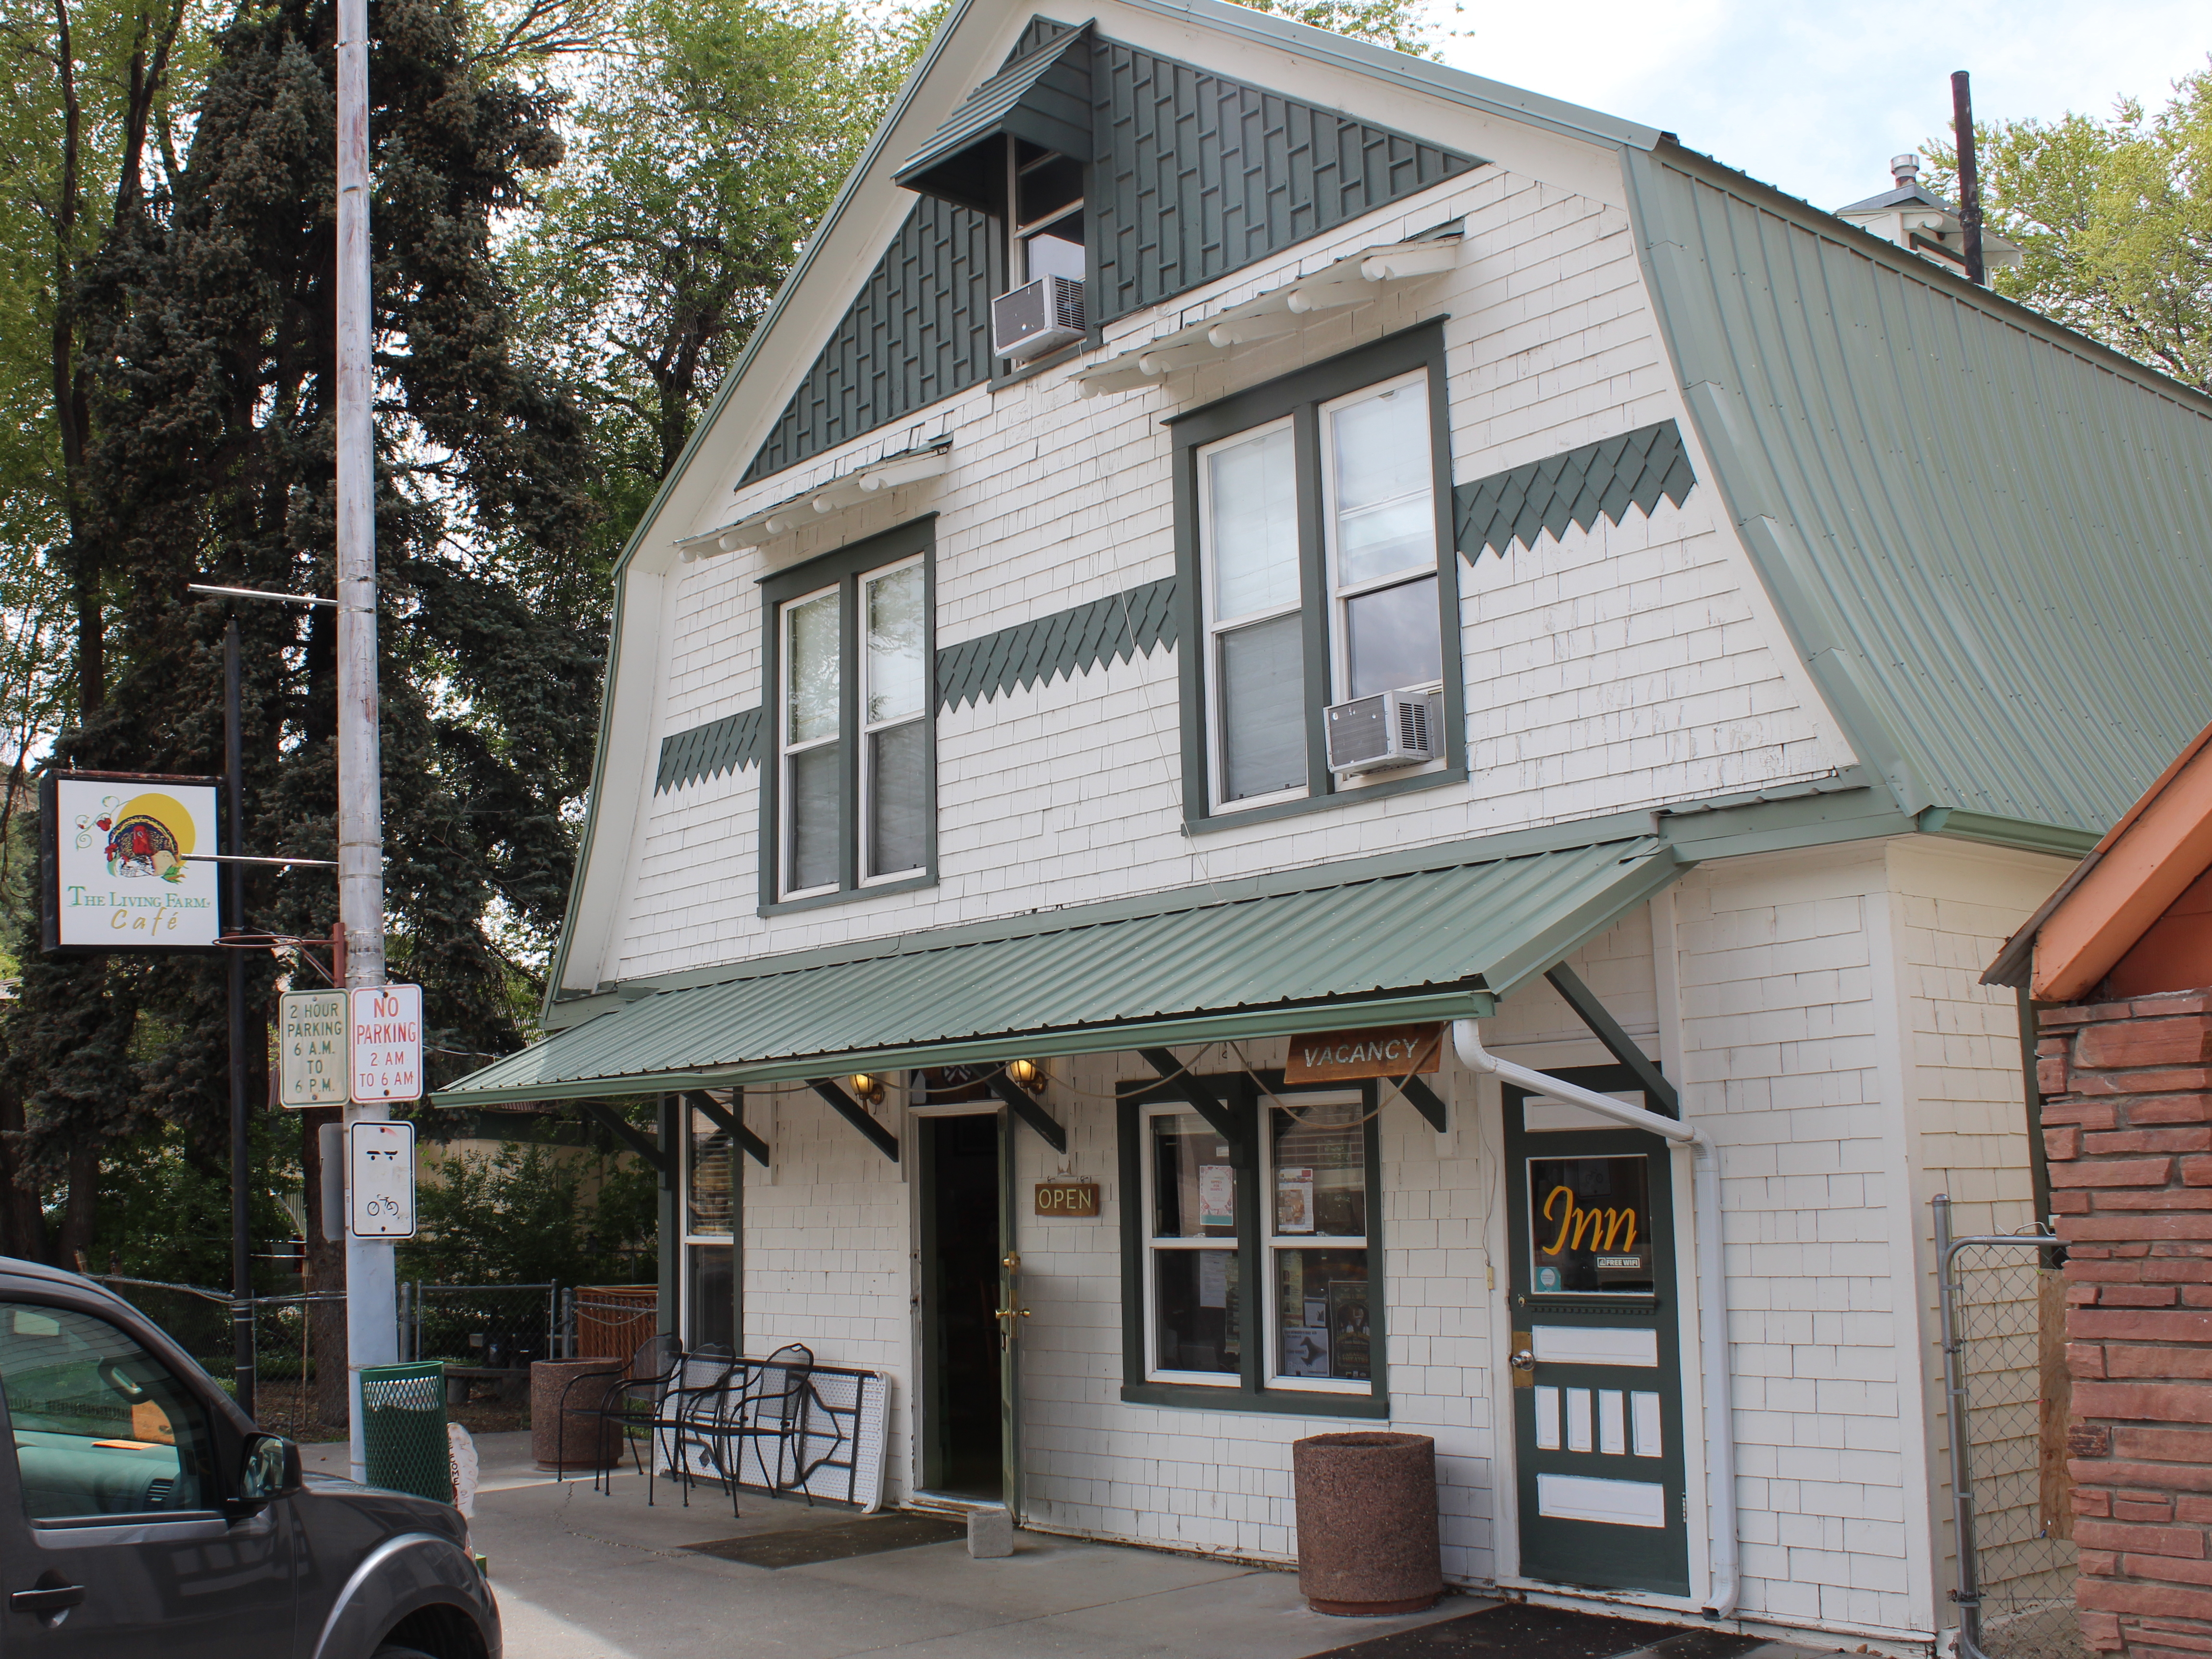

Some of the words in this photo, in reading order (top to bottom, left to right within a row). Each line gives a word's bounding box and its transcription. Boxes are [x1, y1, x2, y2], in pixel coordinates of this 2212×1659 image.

[109, 892, 161, 908] LIVING
[111, 906, 178, 936] Café
[290, 1005, 297, 1019] 2
[304, 1003, 338, 1018] HOUR
[373, 997, 399, 1018] NO
[287, 1021, 342, 1038] PARKING
[357, 1021, 417, 1045] PARKING
[294, 1042, 301, 1056] 6
[309, 1040, 335, 1055] A.M.
[1304, 1037, 1420, 1067] VACANCY
[307, 1060, 323, 1074] TO
[370, 1052, 378, 1066] 2
[385, 1051, 404, 1066] AM
[295, 1080, 302, 1094] 6
[309, 1078, 335, 1092] P.M.
[359, 1072, 374, 1087] TO
[381, 1072, 389, 1086] 6
[394, 1070, 414, 1086] AM
[1038, 1188, 1091, 1209] OPEN
[1542, 1185, 1638, 1256] Inn
